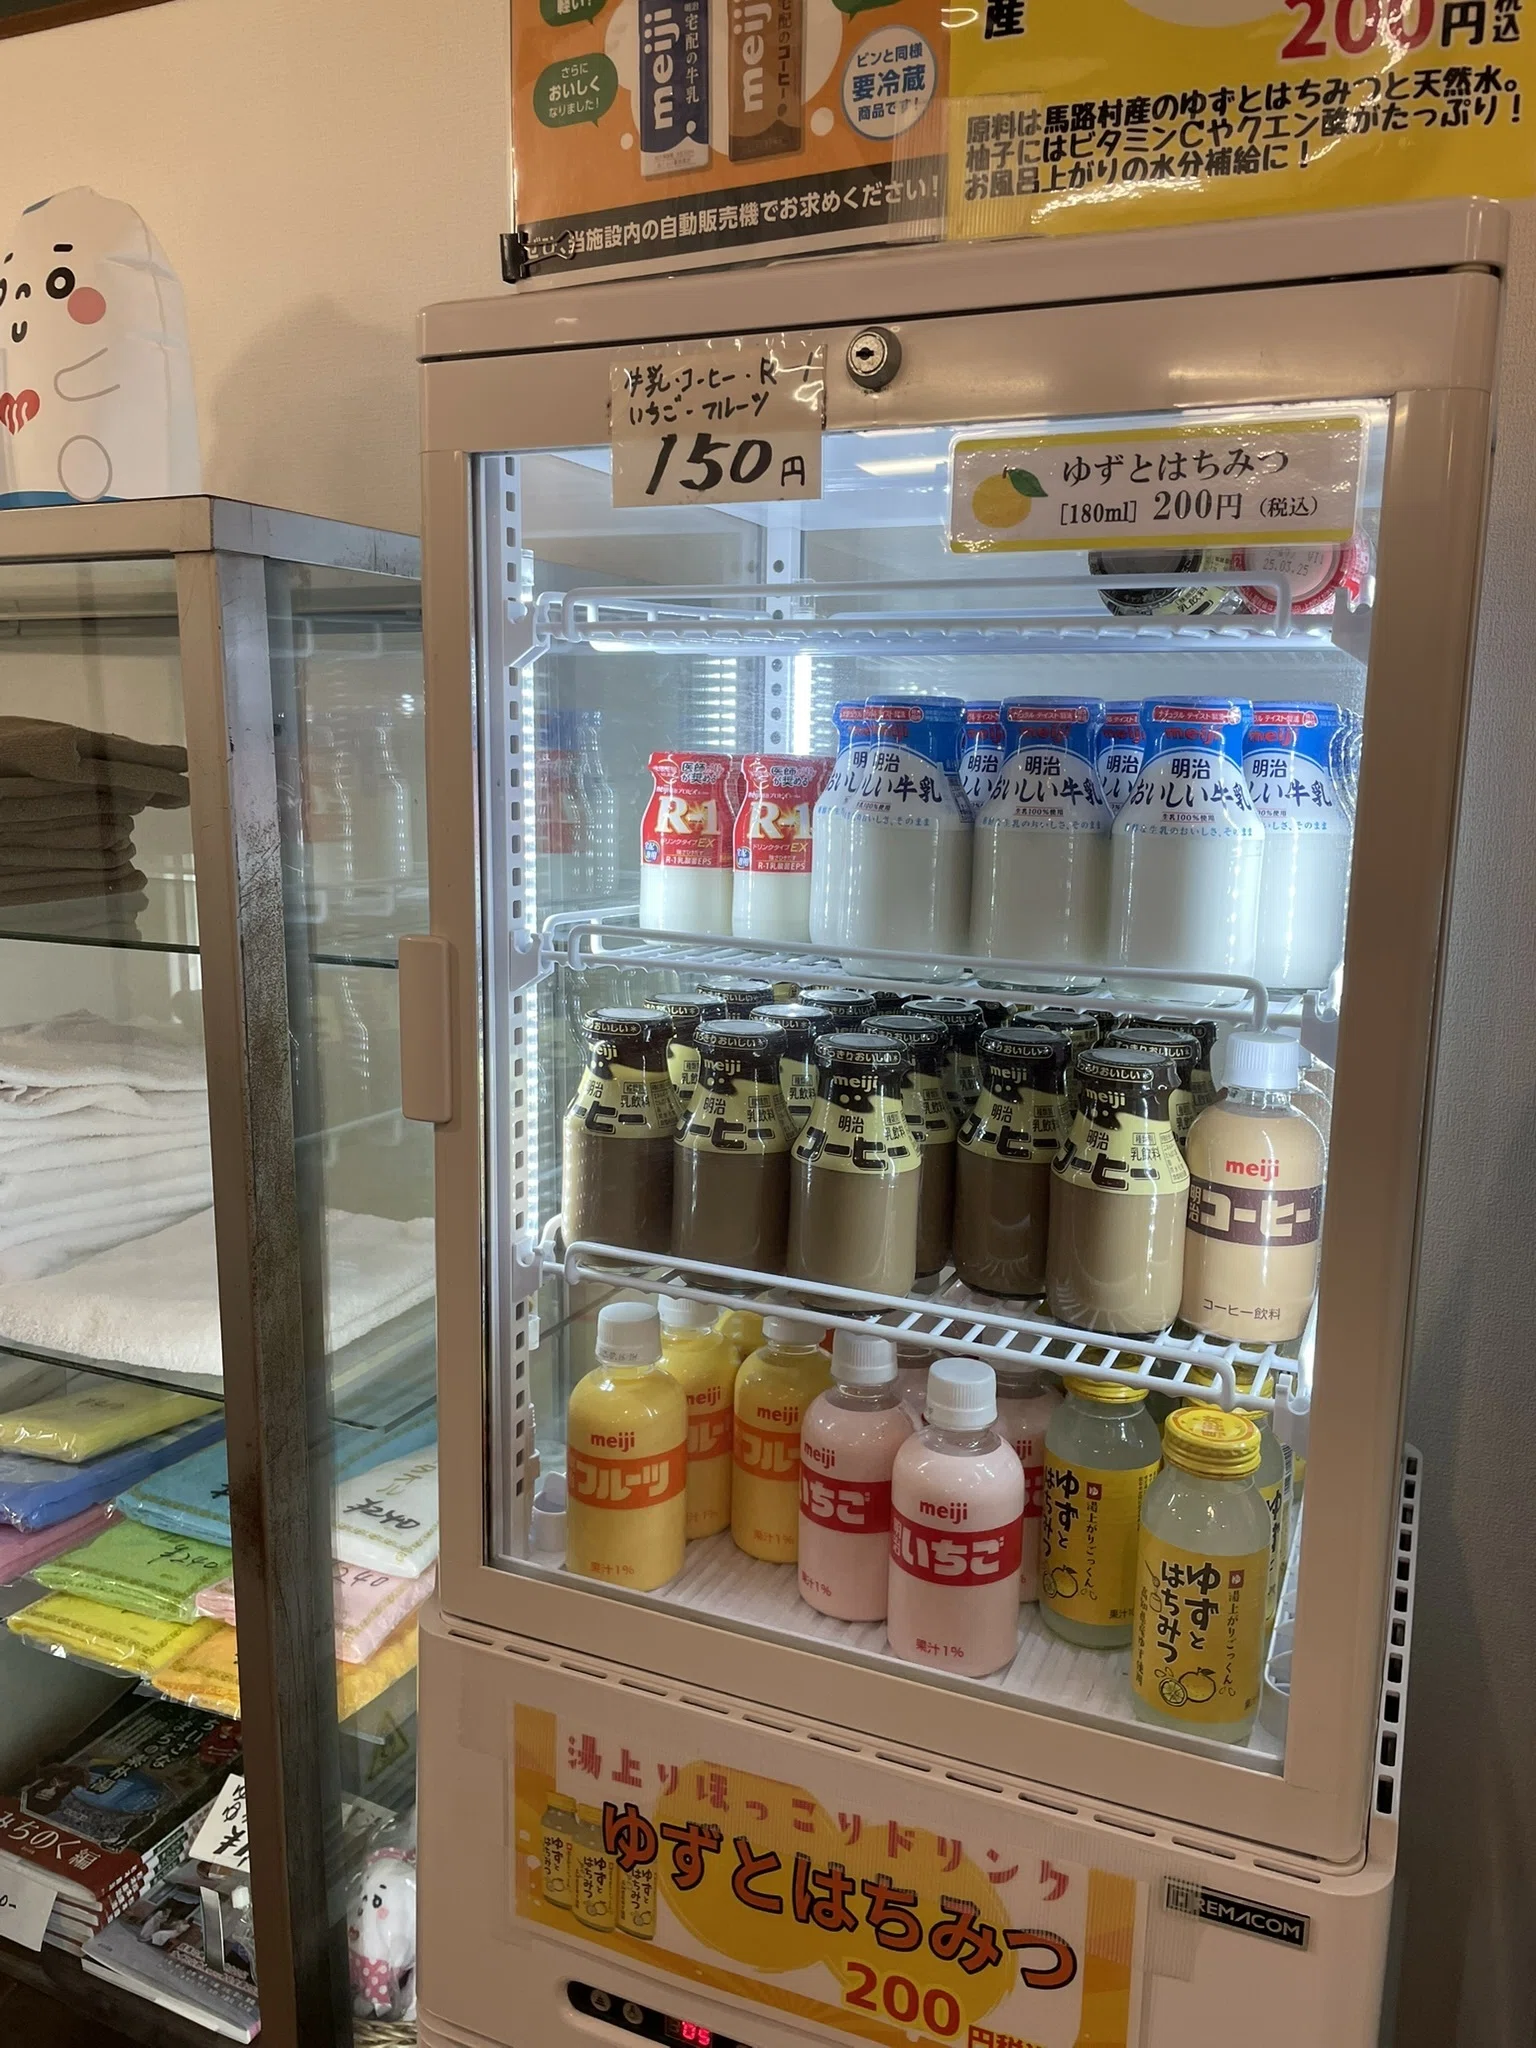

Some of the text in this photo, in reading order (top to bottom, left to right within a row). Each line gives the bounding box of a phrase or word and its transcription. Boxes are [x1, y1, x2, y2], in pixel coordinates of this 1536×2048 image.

[685, 13, 699, 104] 宅配の牛乳
[734, 0, 772, 113] meij
[856, 42, 923, 68] ビンと同様
[561, 62, 588, 79] さらに
[644, 8, 680, 130] meiji
[852, 64, 926, 101] 要冷蔵
[548, 75, 600, 102] おいしく
[548, 97, 600, 118] なりました！
[965, 144, 1311, 200] お風呂上がりの水分補給に！
[645, 432, 805, 495] 150円
[1062, 447, 1289, 488] ゆずとはちみつ
[1061, 500, 1137, 527] [180ml]
[1153, 489, 1243, 521] 200円
[1164, 727, 1222, 745] meiji
[968, 755, 999, 773] 明治
[1025, 756, 1061, 776] 明治
[1106, 755, 1139, 774] 明治
[1171, 758, 1211, 780] 明治
[1252, 758, 1288, 778] 明治
[990, 776, 1103, 806] おいしい牛乳
[1130, 778, 1252, 811] おいしい牛乳
[654, 796, 721, 835] R-1
[747, 801, 813, 839] R-1
[704, 1058, 742, 1076] meiji
[990, 1065, 1027, 1084] meiji
[832, 1075, 879, 1093] meiji
[703, 1097, 726, 1115] 明治
[1086, 1088, 1126, 1109] meiji
[838, 1115, 864, 1134] 明治
[990, 1104, 1013, 1124] 明治
[796, 1126, 909, 1171] コーヒー
[1086, 1130, 1109, 1150] 明治
[1052, 1138, 1160, 1191] コーヒー
[1130, 1147, 1161, 1162] 乳飲料
[1225, 1158, 1280, 1182] meiji
[1189, 1184, 1201, 1223] 明治
[1201, 1189, 1311, 1237] コーヒー
[1203, 1298, 1280, 1321] コーヒー飲料
[757, 1406, 799, 1426] meiji
[591, 1432, 635, 1452] meiji
[804, 1442, 836, 1469] meiji
[576, 1460, 669, 1501] フルーツ
[920, 1500, 968, 1525] meiji
[1055, 1469, 1080, 1549] ゆずと
[901, 1528, 1005, 1577] いちご
[1085, 1501, 1099, 1588] 湯上がりごっくん
[1157, 1560, 1186, 1664] はちみつ
[1184, 1562, 1222, 1651] ゆずと
[916, 1638, 964, 1658] 果汁1%
[1223, 1590, 1239, 1685] 湯上がりごっくん
[566, 1733, 1070, 1902] 湯上りほっこりドリンク
[602, 1800, 1079, 1990] ゆずとはちみつ
